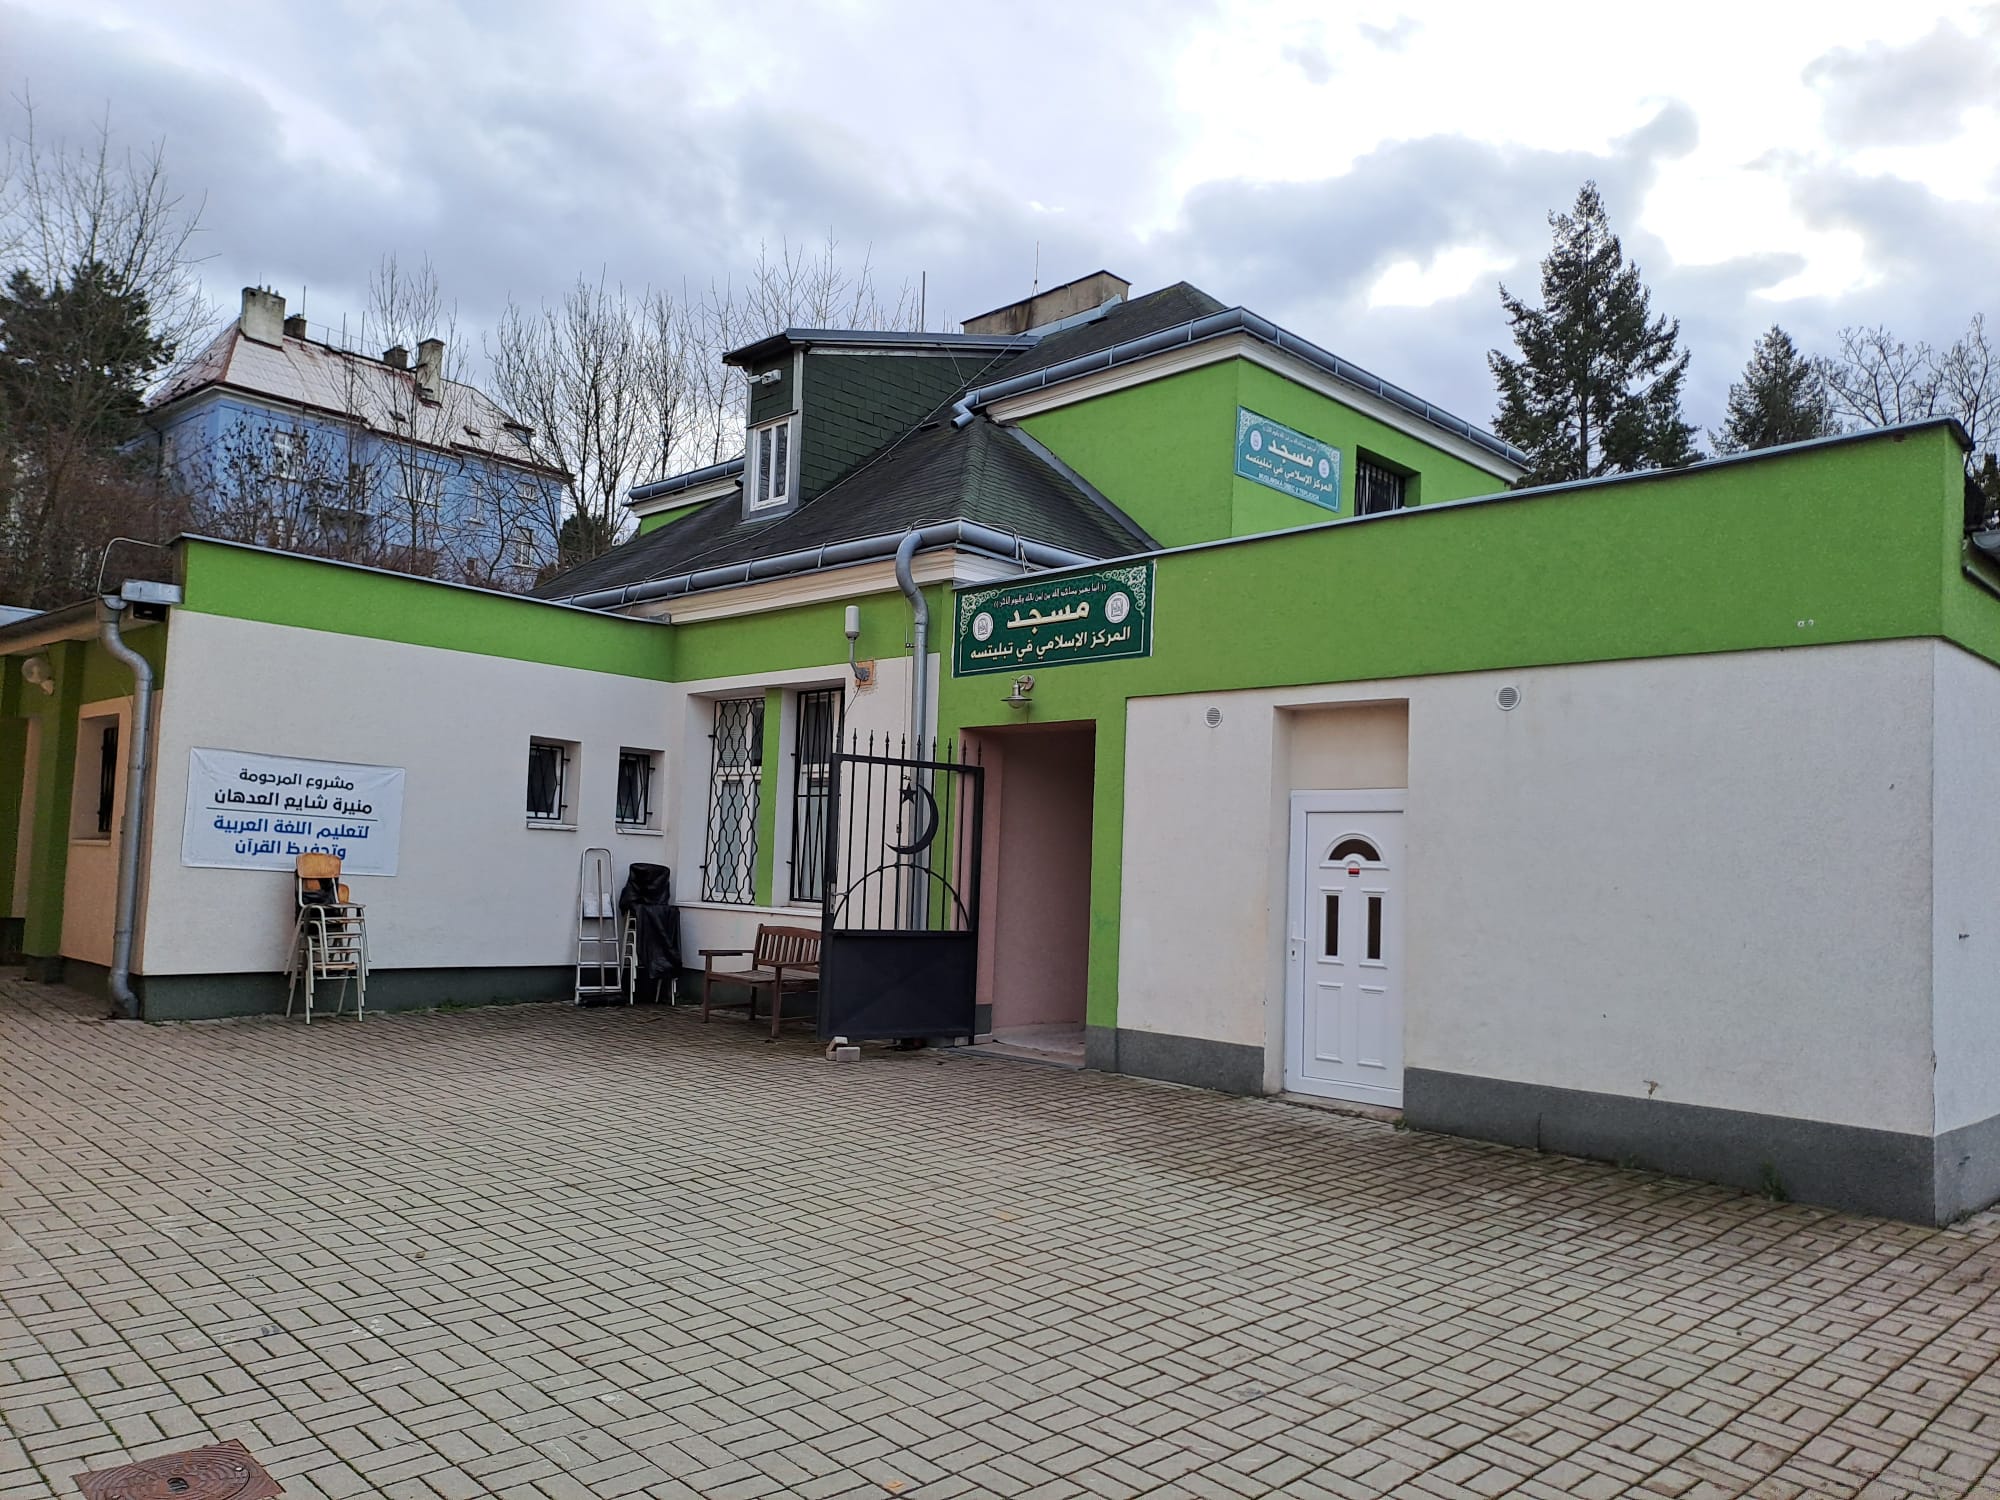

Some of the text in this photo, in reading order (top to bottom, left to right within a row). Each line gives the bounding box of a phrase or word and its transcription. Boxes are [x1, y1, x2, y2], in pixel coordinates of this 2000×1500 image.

[1268, 440, 1313, 468] مسجد
[1007, 601, 1090, 634] مسجد
[970, 626, 1131, 661] المركز الإسلامي في تبليتسه
[239, 768, 354, 790] مشروع المرحومة
[214, 789, 372, 814] منيرة شايع العدهان
[213, 815, 369, 840] لتعليم اللغة العربية
[235, 838, 281, 856] القرآن
